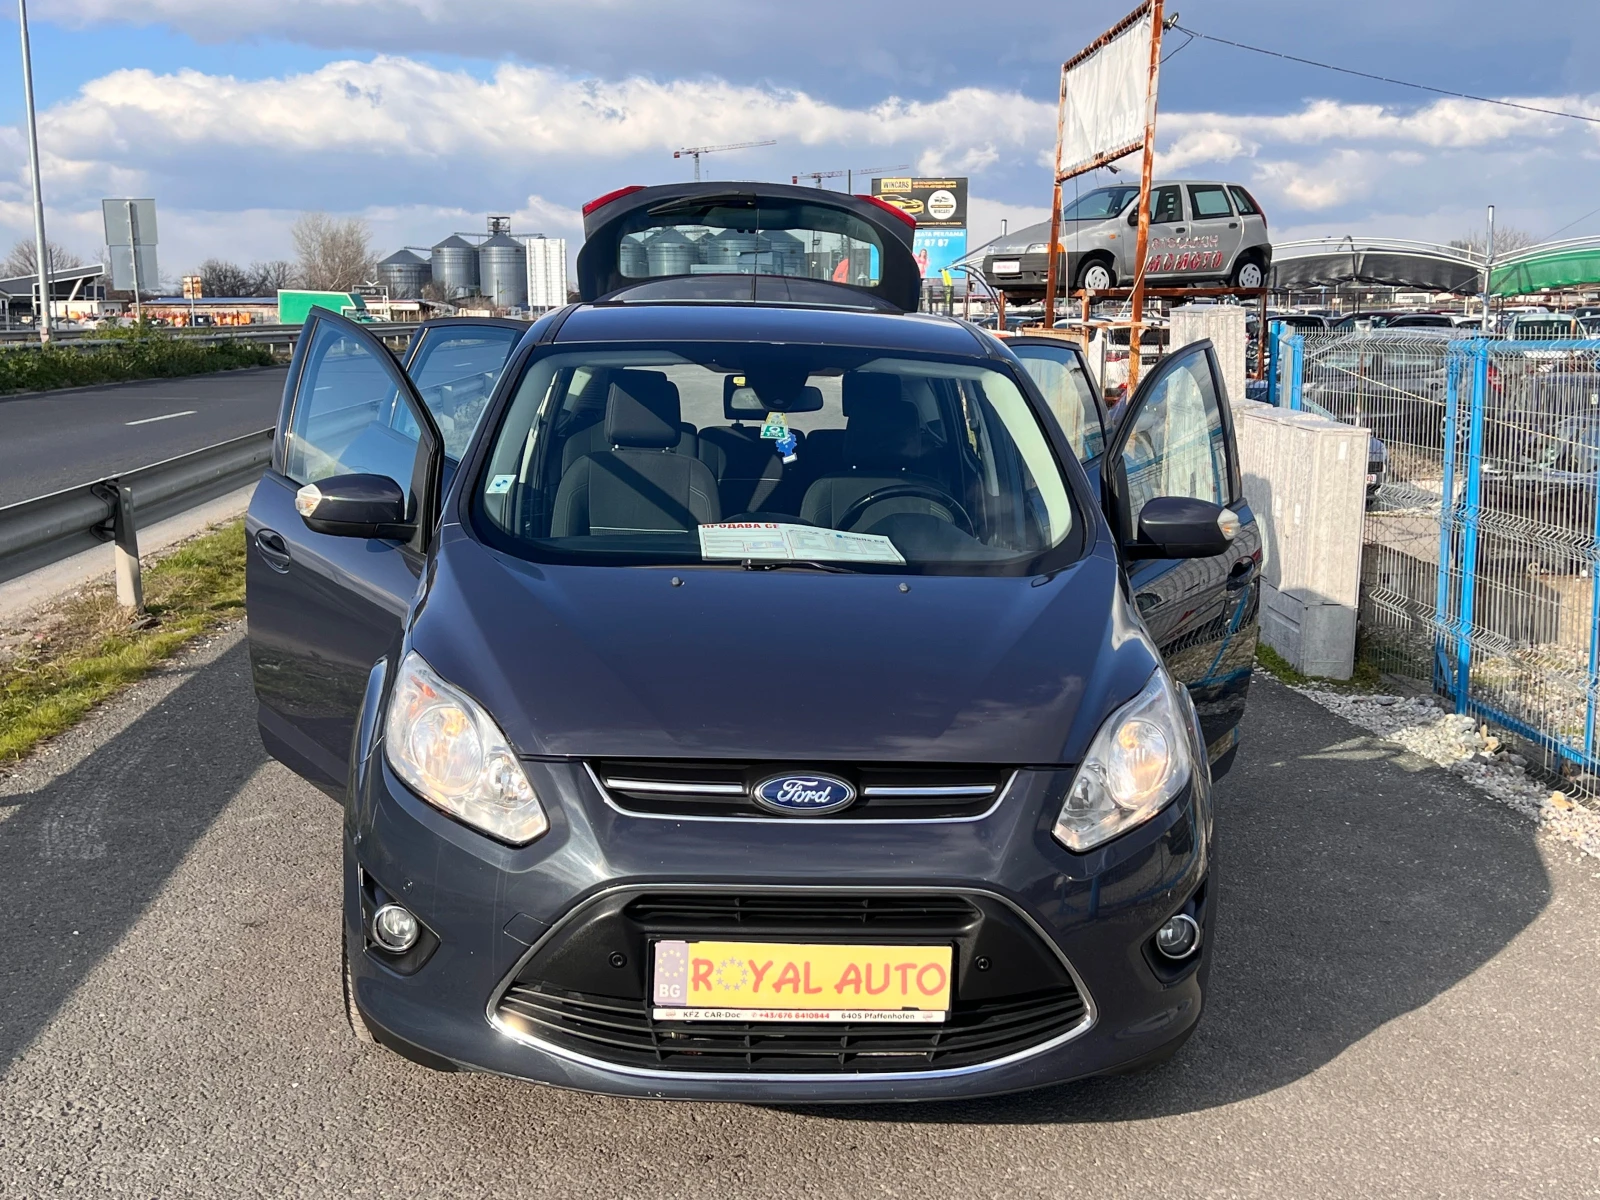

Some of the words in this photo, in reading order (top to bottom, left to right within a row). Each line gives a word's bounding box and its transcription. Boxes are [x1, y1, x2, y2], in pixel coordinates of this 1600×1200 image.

[883, 181, 910, 189] WINCARS
[777, 780, 831, 803] Ford
[659, 984, 681, 998] BG
[833, 963, 947, 996] AUTO
[864, 1012, 915, 1020] Pfaffenhofen
